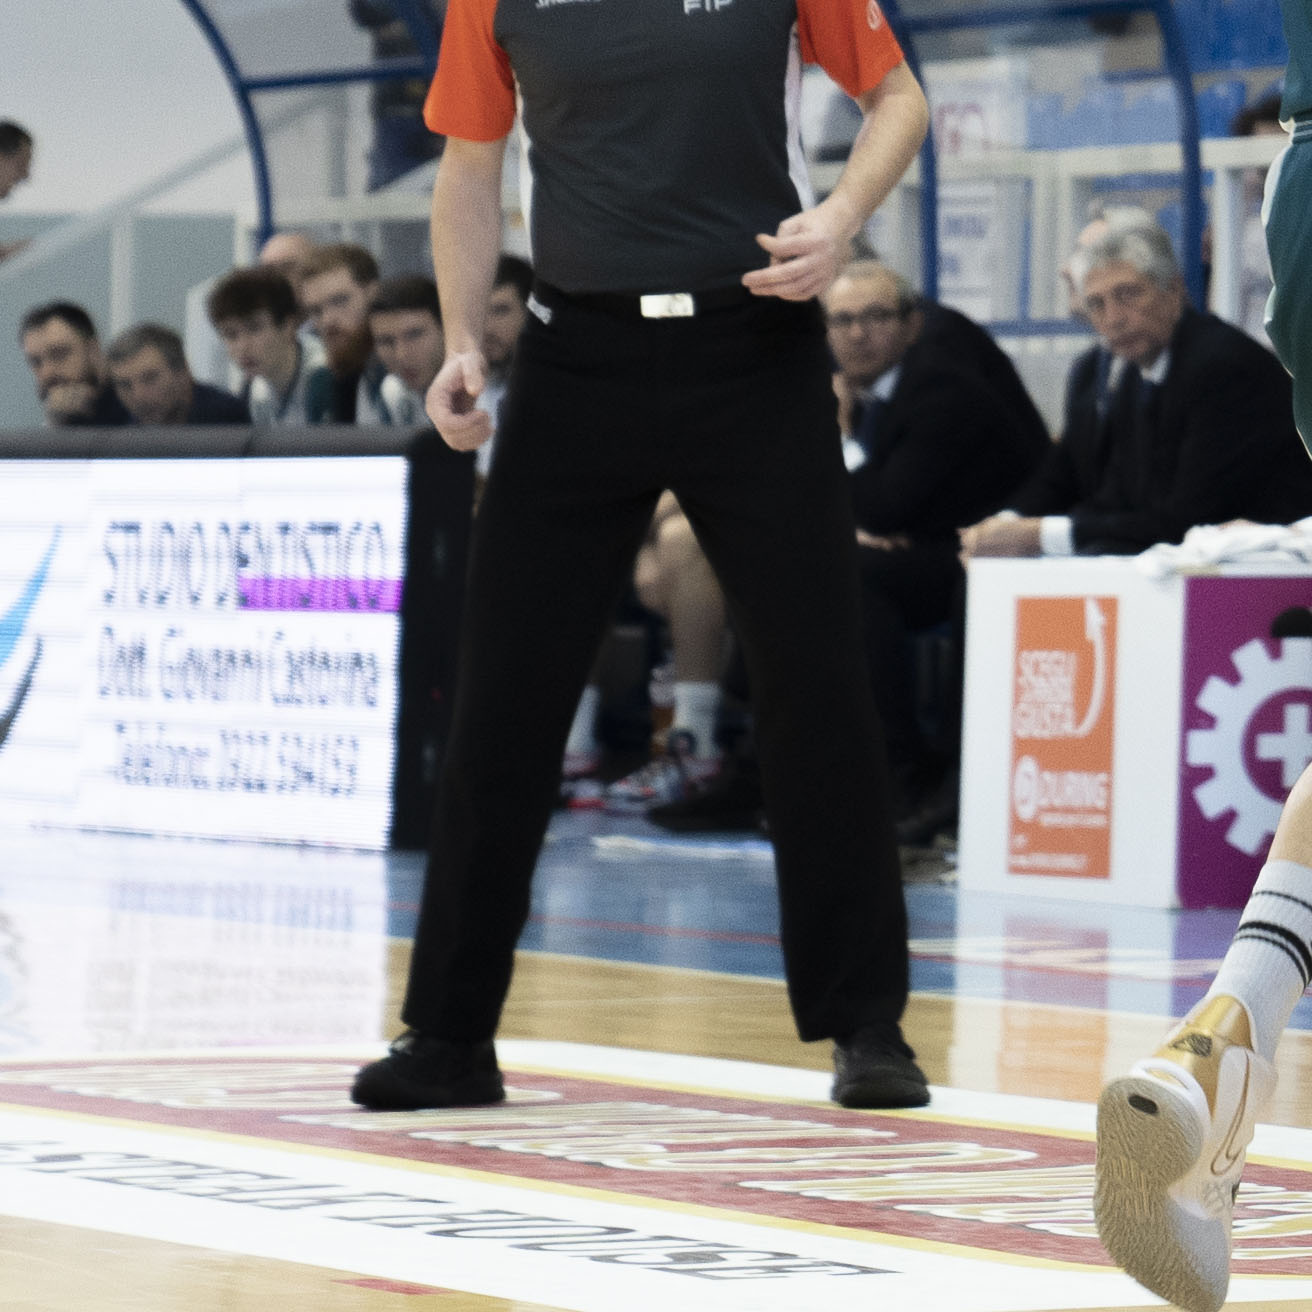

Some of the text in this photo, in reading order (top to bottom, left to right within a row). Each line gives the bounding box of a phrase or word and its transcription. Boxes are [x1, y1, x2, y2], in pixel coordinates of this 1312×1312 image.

[102, 520, 388, 611] STUDIO DENTISTICO
[330, 1208, 902, 1280] HOUSE
